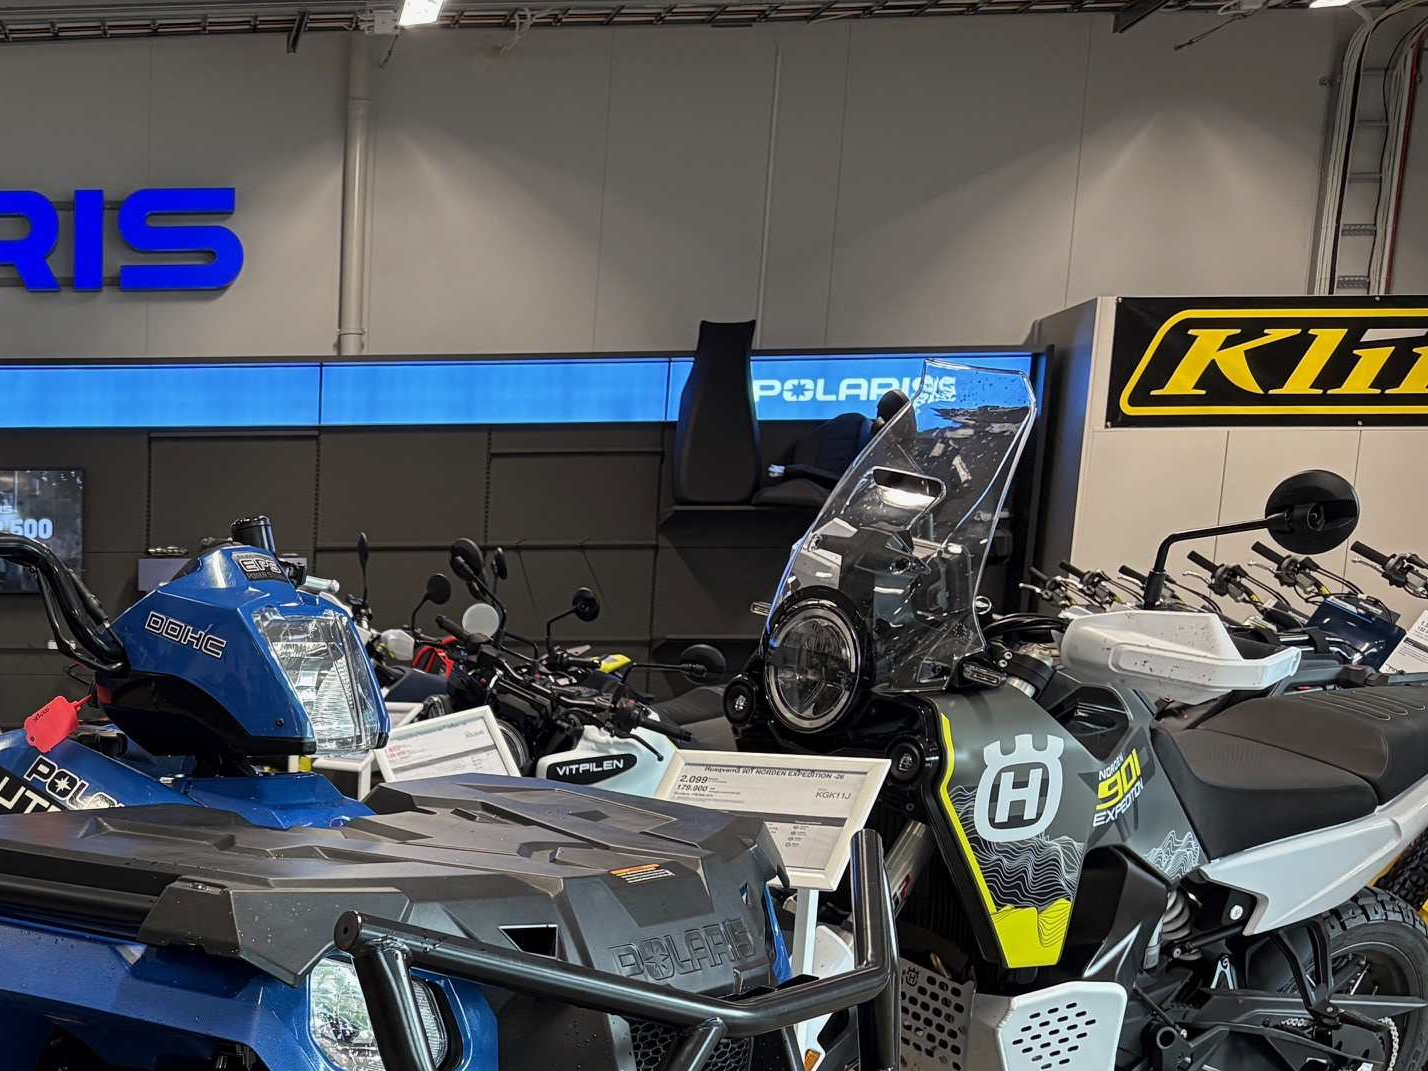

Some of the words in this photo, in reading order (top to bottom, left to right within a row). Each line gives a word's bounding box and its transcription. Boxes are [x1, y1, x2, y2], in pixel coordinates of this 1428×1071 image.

[1149, 328, 1428, 396] Kli
[753, 375, 956, 405] POLARIS
[239, 557, 282, 574] EPS
[145, 610, 227, 658] DOHC
[556, 759, 624, 776] VITPILEN
[704, 766, 741, 774] Husqvarna
[787, 771, 832, 779] EXPEDITION
[24, 755, 125, 810] POLA
[677, 784, 708, 792] 179.900
[679, 775, 708, 784] 2.099
[1096, 748, 1142, 811] 901
[815, 791, 851, 800] KGK11J
[608, 917, 756, 981] POLARIS
